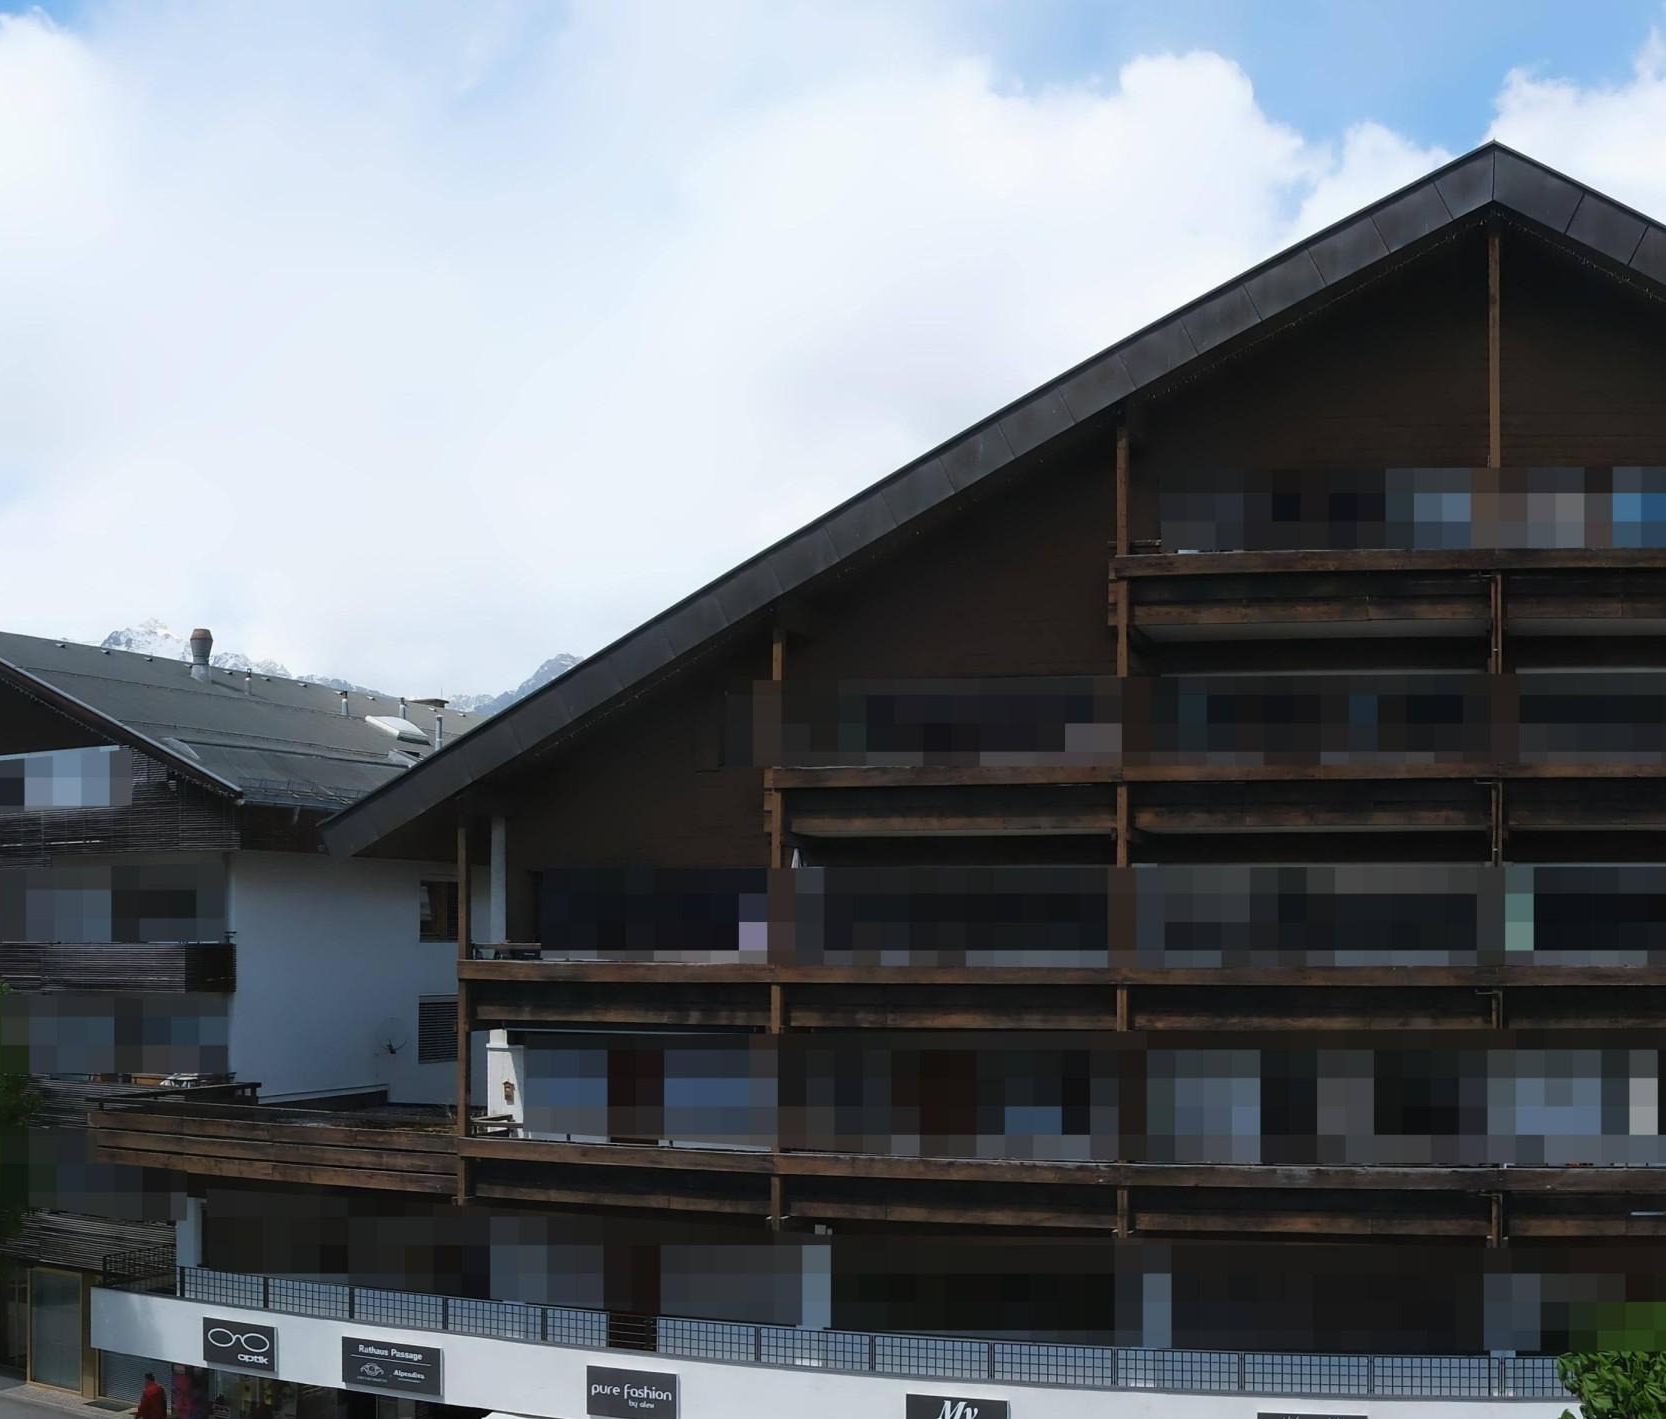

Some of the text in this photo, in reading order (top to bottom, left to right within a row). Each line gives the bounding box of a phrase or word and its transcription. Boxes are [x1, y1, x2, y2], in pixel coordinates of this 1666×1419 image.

[237, 1353, 269, 1365] optik
[358, 1344, 423, 1362] Rathaus Passage
[591, 1383, 672, 1401] pure fashion
[628, 1399, 655, 1409] by alex
